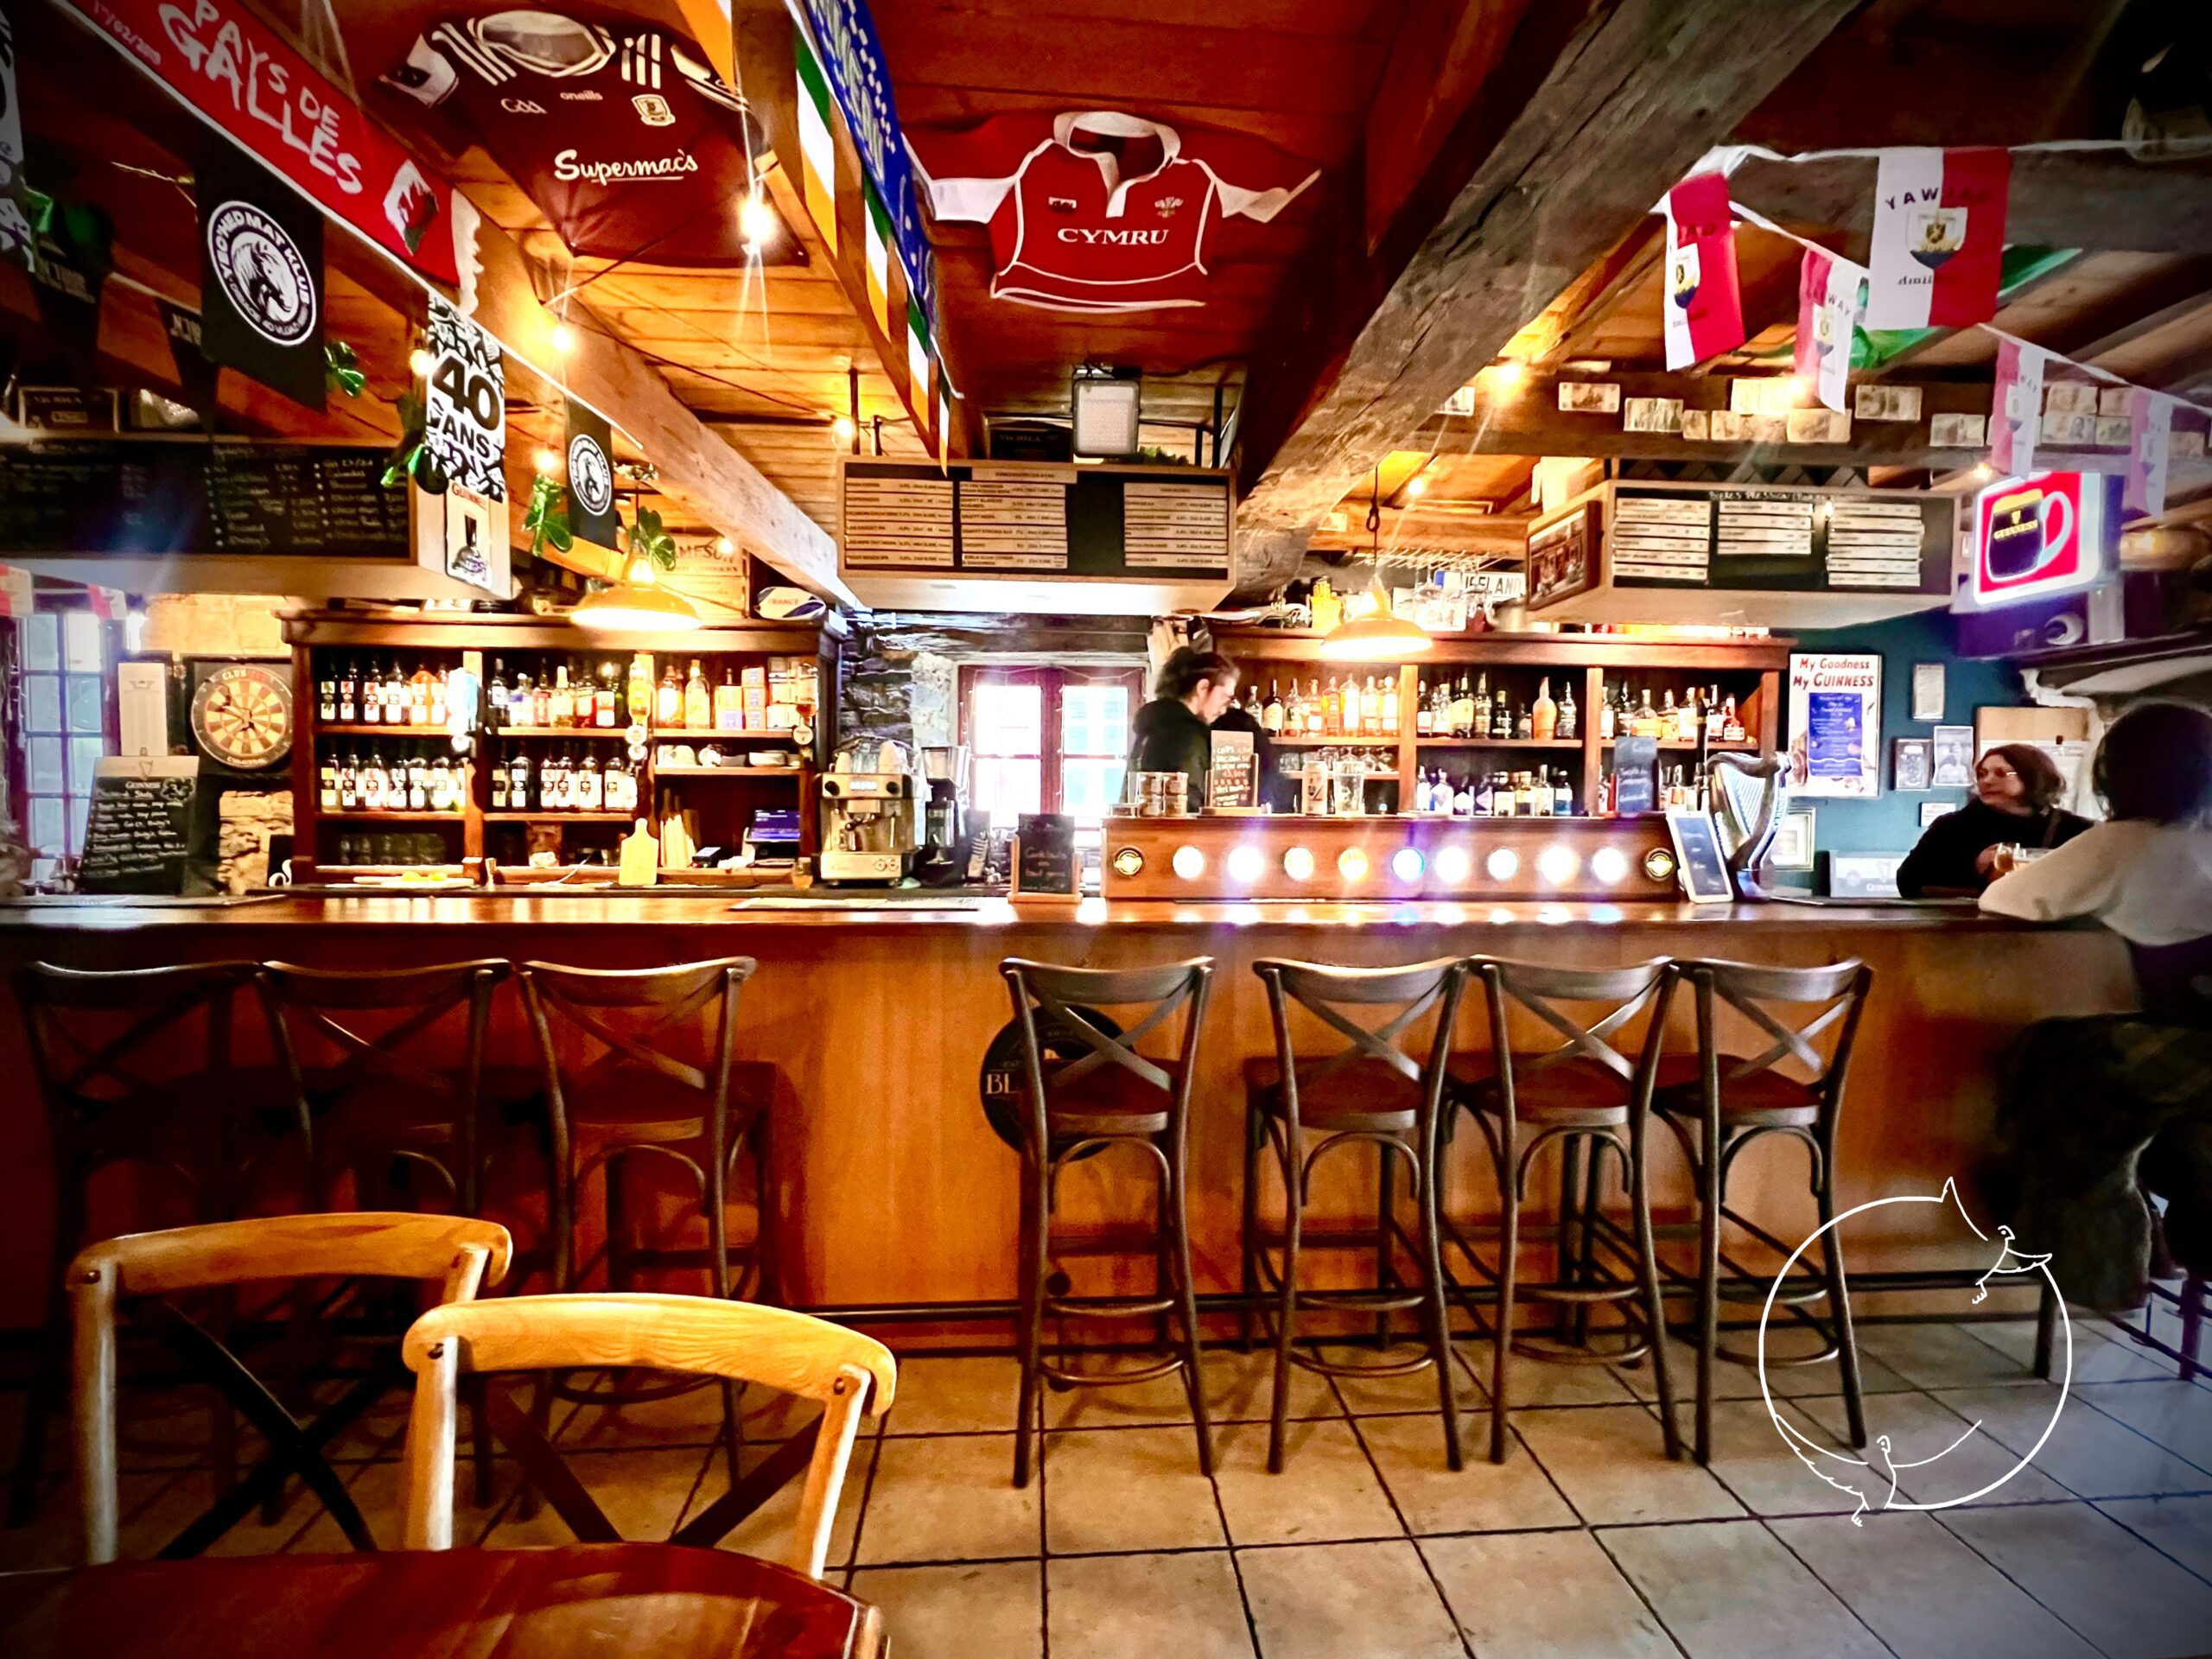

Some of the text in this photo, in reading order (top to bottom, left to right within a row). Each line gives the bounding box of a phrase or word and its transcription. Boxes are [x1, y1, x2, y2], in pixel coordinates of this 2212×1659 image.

[195, 0, 340, 137] PAYS DE
[158, 3, 363, 194] GALLES
[554, 148, 698, 186] Supermac's
[1057, 227, 1169, 246] CYMRU
[284, 247, 310, 305] KLUB
[432, 355, 501, 431] 40
[442, 416, 492, 458] ANS
[1793, 672, 1875, 690] My GUINNESS
[1799, 658, 1870, 671] My Goodness
